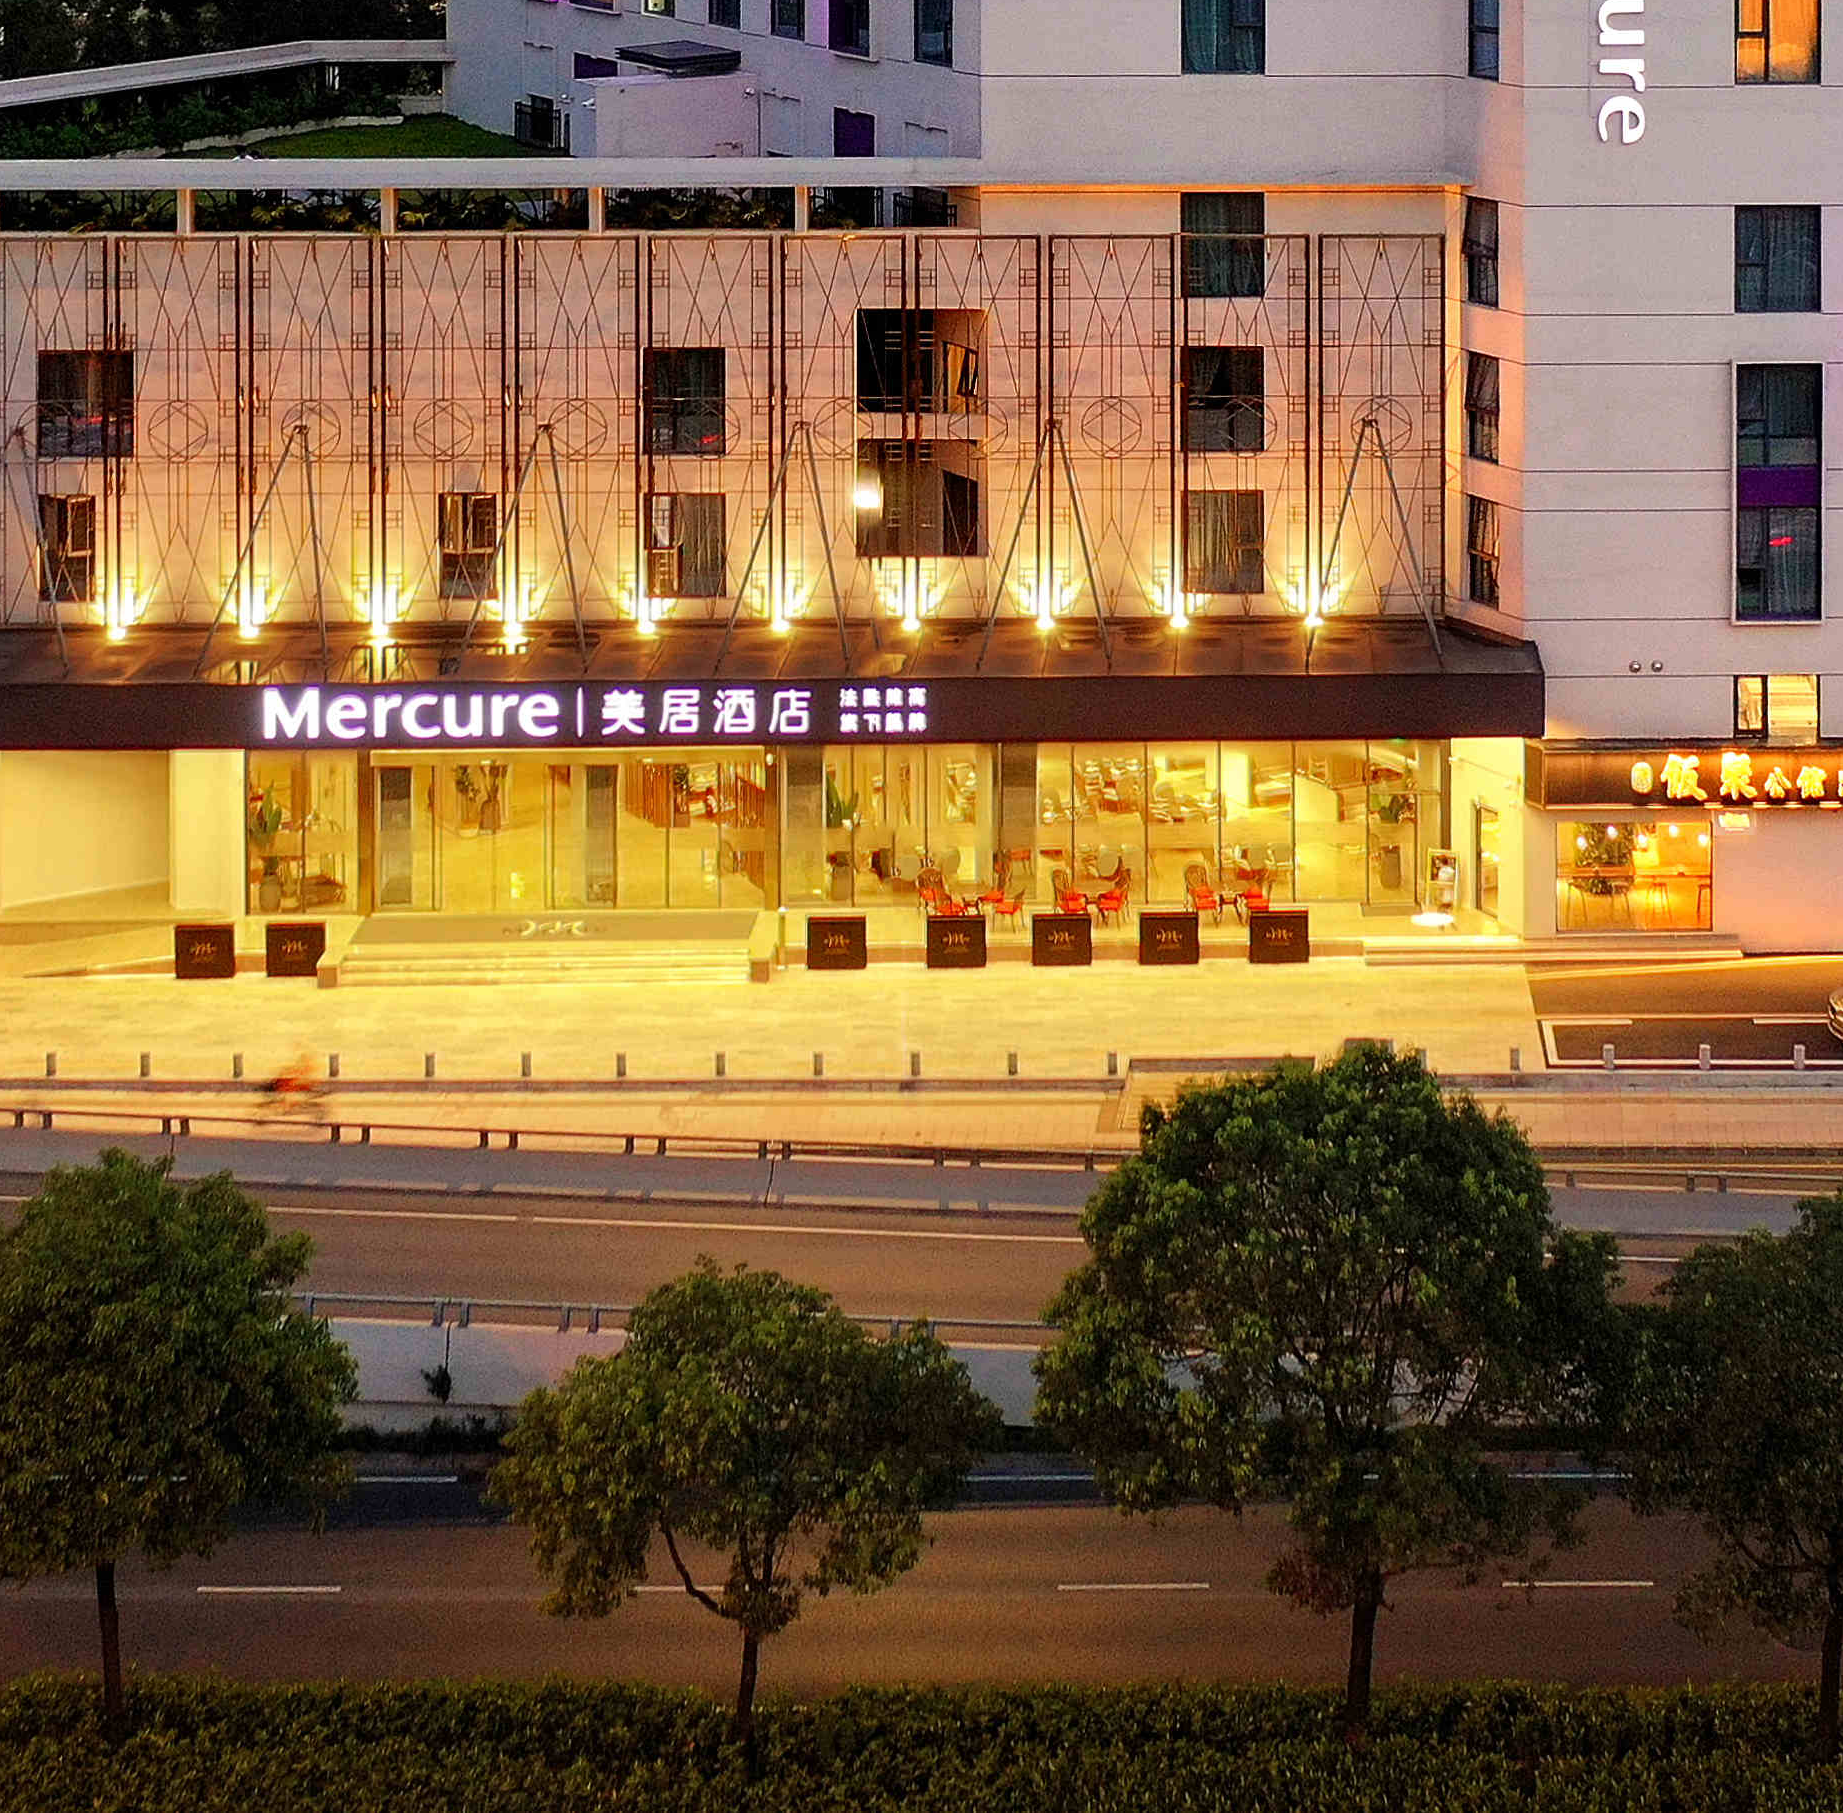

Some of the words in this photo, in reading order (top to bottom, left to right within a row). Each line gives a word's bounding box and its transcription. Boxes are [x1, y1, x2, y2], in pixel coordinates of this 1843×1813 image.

[262, 686, 559, 740] Mercure
[600, 688, 812, 736] 美居酒店
